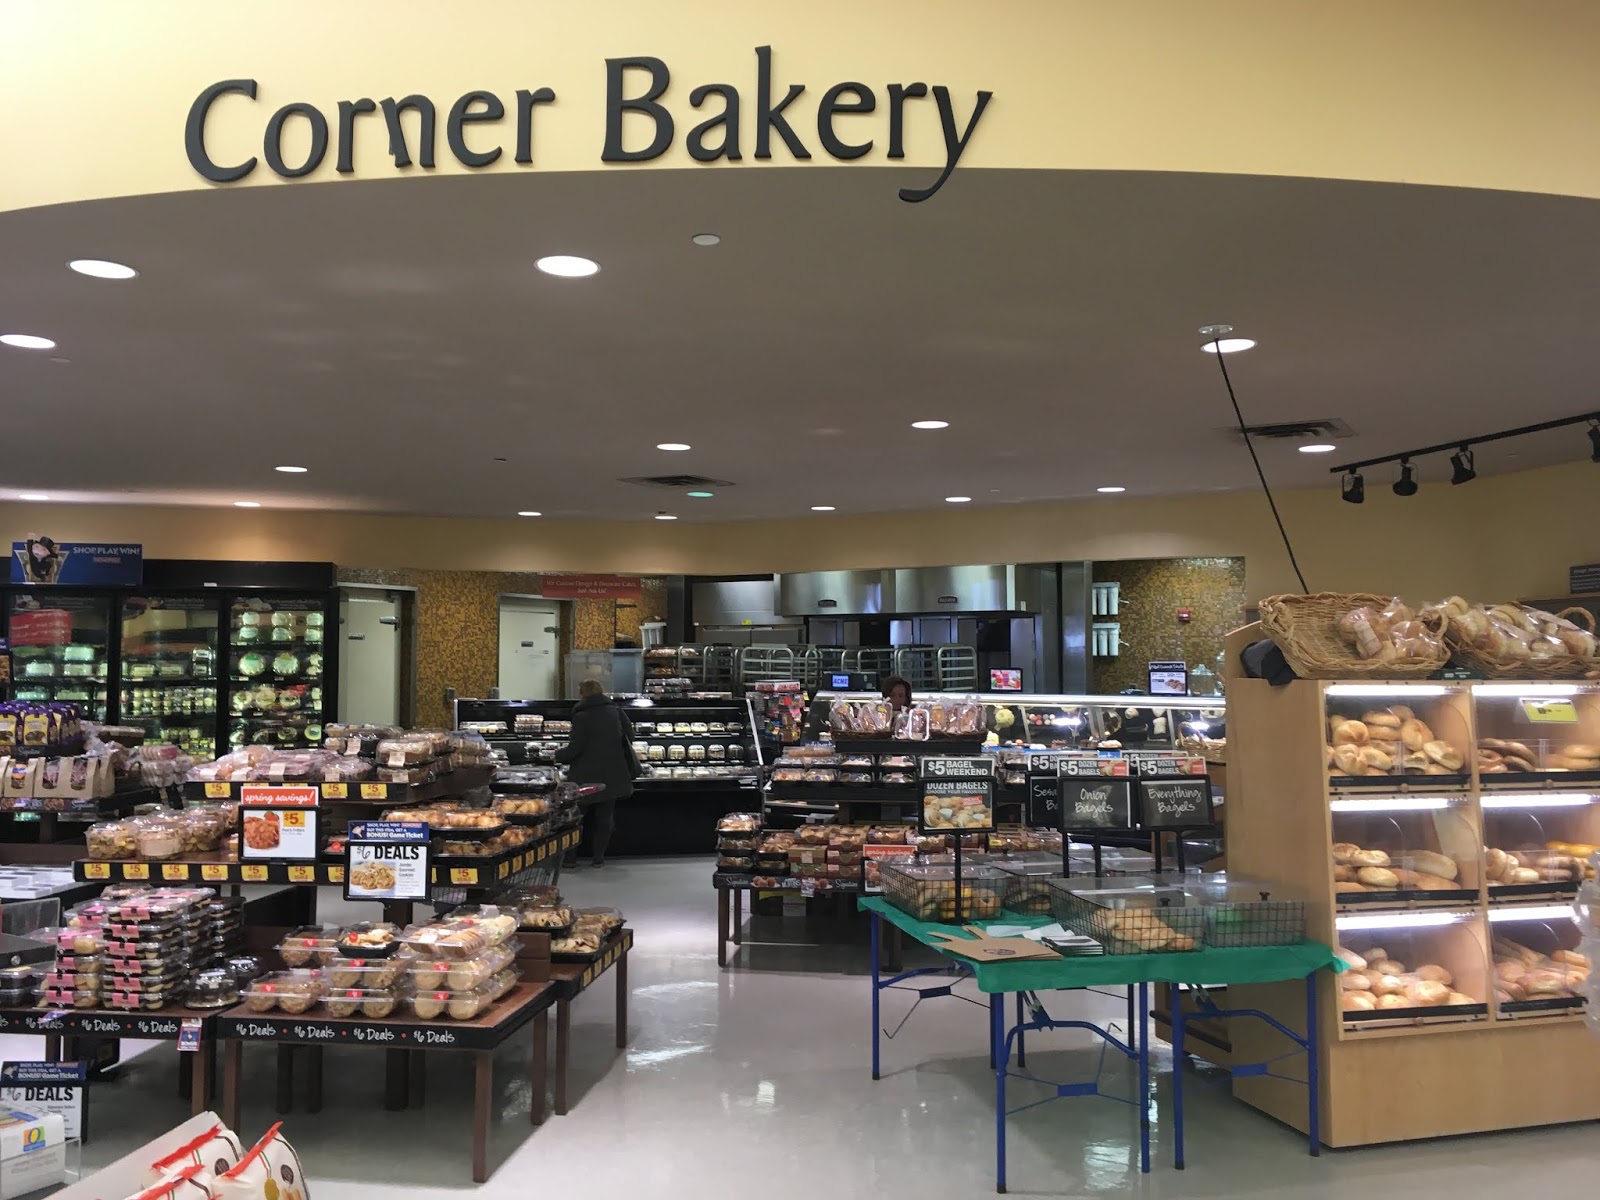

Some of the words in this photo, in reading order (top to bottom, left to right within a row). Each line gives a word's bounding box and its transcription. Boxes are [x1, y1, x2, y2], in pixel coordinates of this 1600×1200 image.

[184, 78, 555, 183] Corner
[600, 45, 994, 202] Bakery
[120, 547, 140, 555] WIN!
[928, 761, 945, 775] $5
[1032, 756, 1050, 770] $5
[1060, 761, 1078, 775] $5
[1141, 760, 1158, 775] $5
[946, 768, 988, 776] WEEKEND
[211, 782, 223, 791] $5
[328, 783, 339, 792] $5
[368, 784, 379, 793] $5
[926, 782, 954, 790] DOZEN
[956, 782, 988, 790] BAGELS
[245, 793, 274, 805] spring
[275, 790, 315, 805] savings!
[1080, 788, 1107, 801] Onion
[1148, 786, 1201, 804] Everything
[1075, 801, 1114, 818] Bagels
[1158, 801, 1196, 817] Bagels
[284, 812, 299, 825] $5
[374, 846, 420, 860] DEALS
[91, 863, 102, 872] $5
[130, 864, 141, 873] $5
[169, 865, 180, 873] $5
[208, 865, 220, 874] $5
[249, 865, 260, 874] $5
[295, 866, 306, 875] $5
[457, 868, 469, 877] $5
[26, 1017, 36, 1029] $6
[82, 1019, 92, 1031] $6
[94, 1019, 121, 1032] Deals
[138, 1021, 149, 1033] $6
[150, 1021, 178, 1033] Deals
[236, 1023, 247, 1036] $6
[249, 1023, 276, 1036] Deals
[294, 1025, 305, 1038] $6
[308, 1025, 335, 1039] Deals
[354, 1028, 365, 1040] $6
[367, 1027, 395, 1041] Deals
[414, 1030, 425, 1042] $6
[427, 1030, 455, 1044] Deals
[25, 1087, 74, 1101] DEALS
